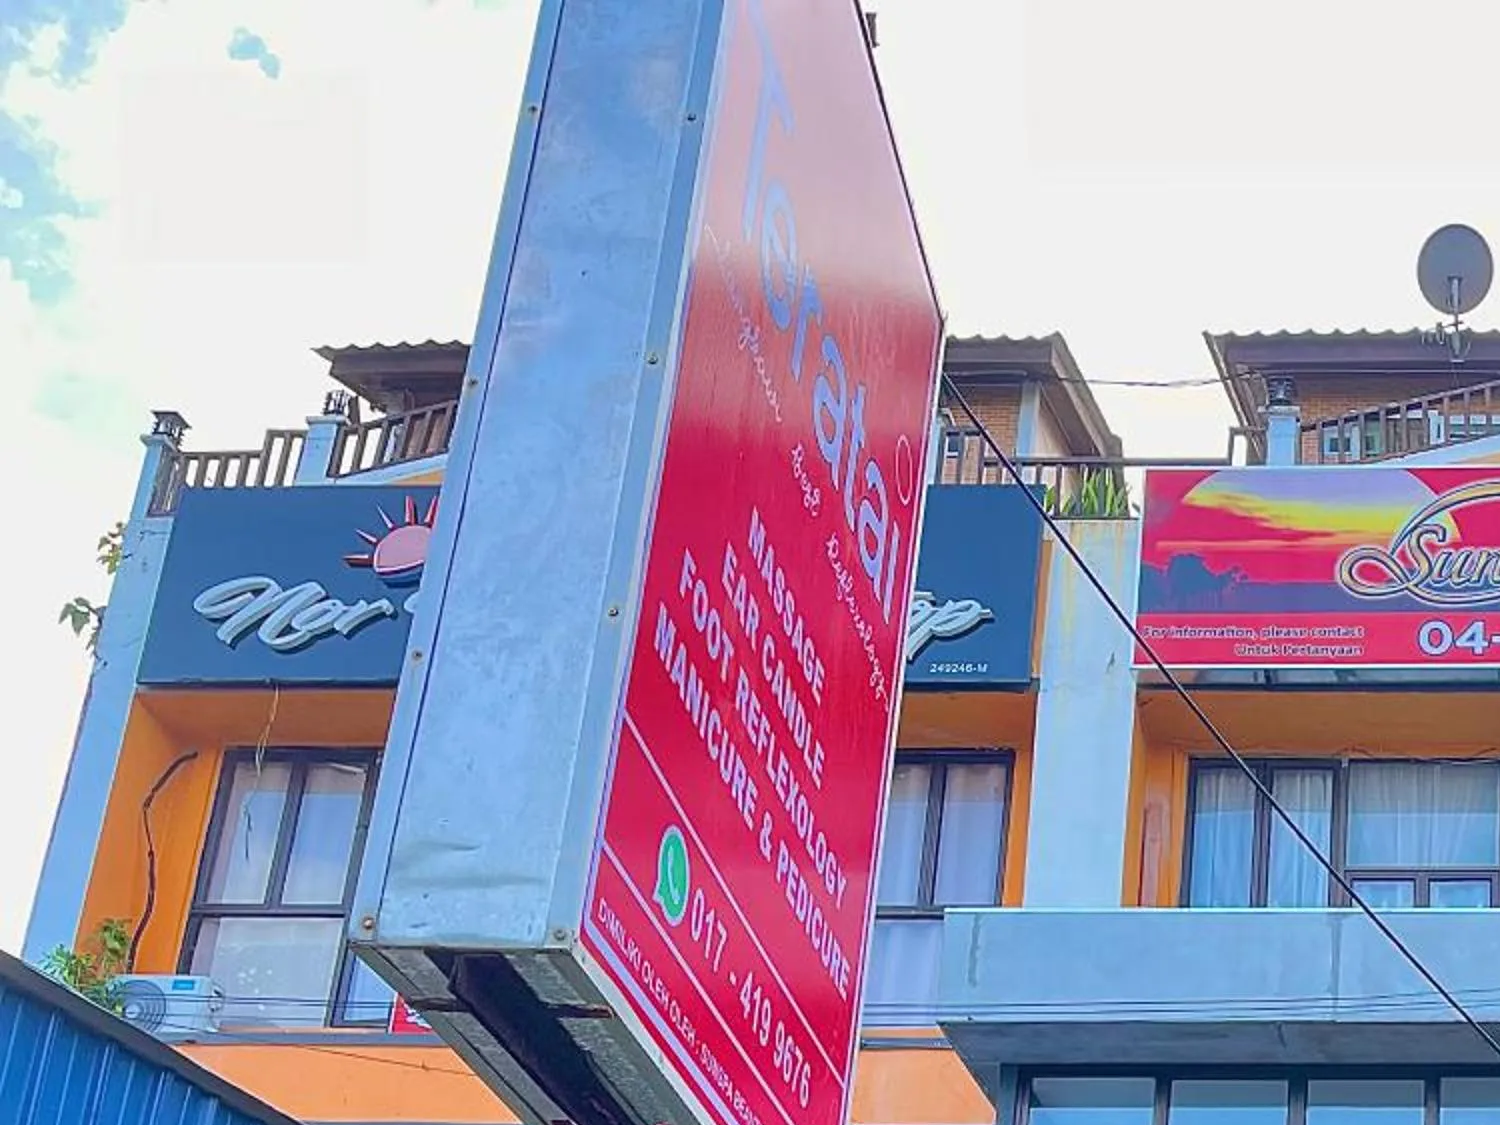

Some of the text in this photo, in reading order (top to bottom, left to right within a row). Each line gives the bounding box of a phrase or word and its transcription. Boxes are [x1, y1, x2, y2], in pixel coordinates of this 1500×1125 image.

[721, 539, 825, 791] EAR CANDLE
[747, 504, 825, 704] MASSAGE
[1260, 626, 1309, 642] please
[1310, 626, 1365, 639] contact
[653, 601, 852, 1001] MANICURE & PEDICURE
[679, 548, 848, 911] FOOT REFLEXOLOGY
[691, 888, 728, 973] 017
[739, 971, 772, 1047] 419
[773, 1020, 812, 1109] 9676
